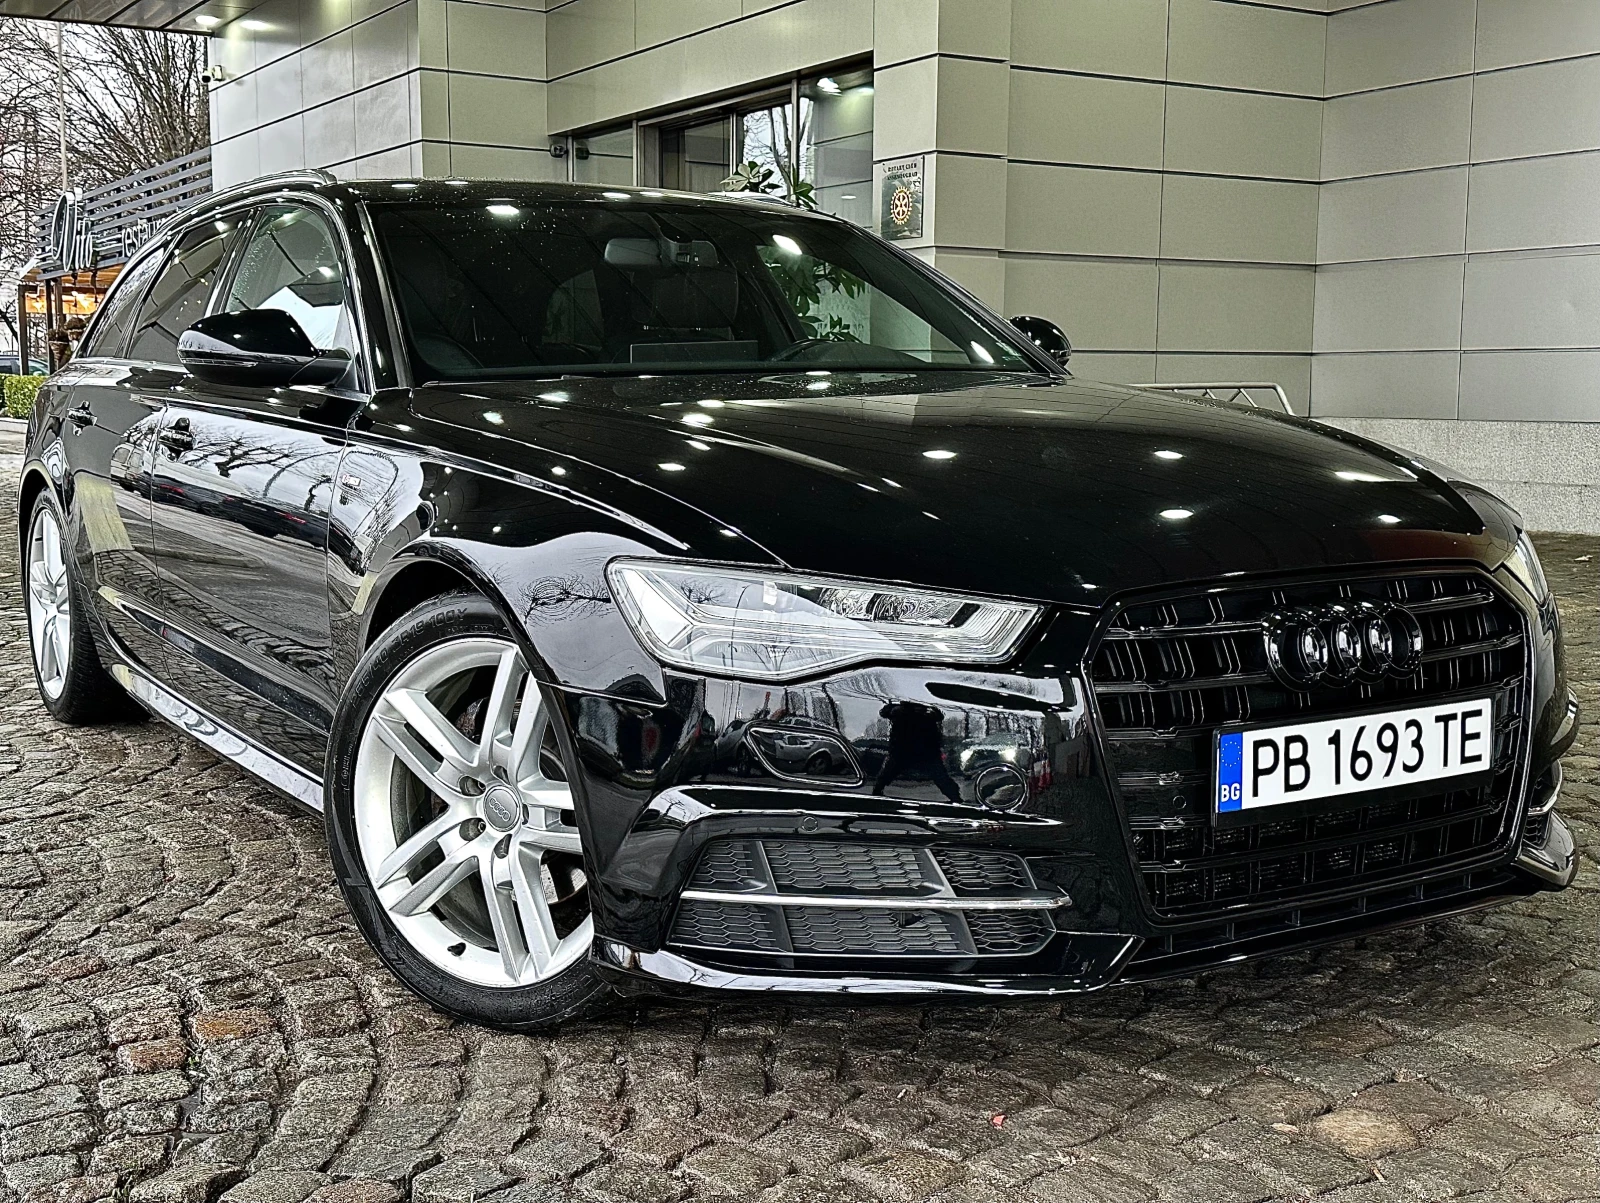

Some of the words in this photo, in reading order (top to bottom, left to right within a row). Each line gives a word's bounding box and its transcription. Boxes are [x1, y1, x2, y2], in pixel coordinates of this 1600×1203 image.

[1252, 734, 1311, 798] PB
[1327, 718, 1424, 786] 1693
[1435, 708, 1483, 769] TE
[1220, 782, 1241, 802] BG
